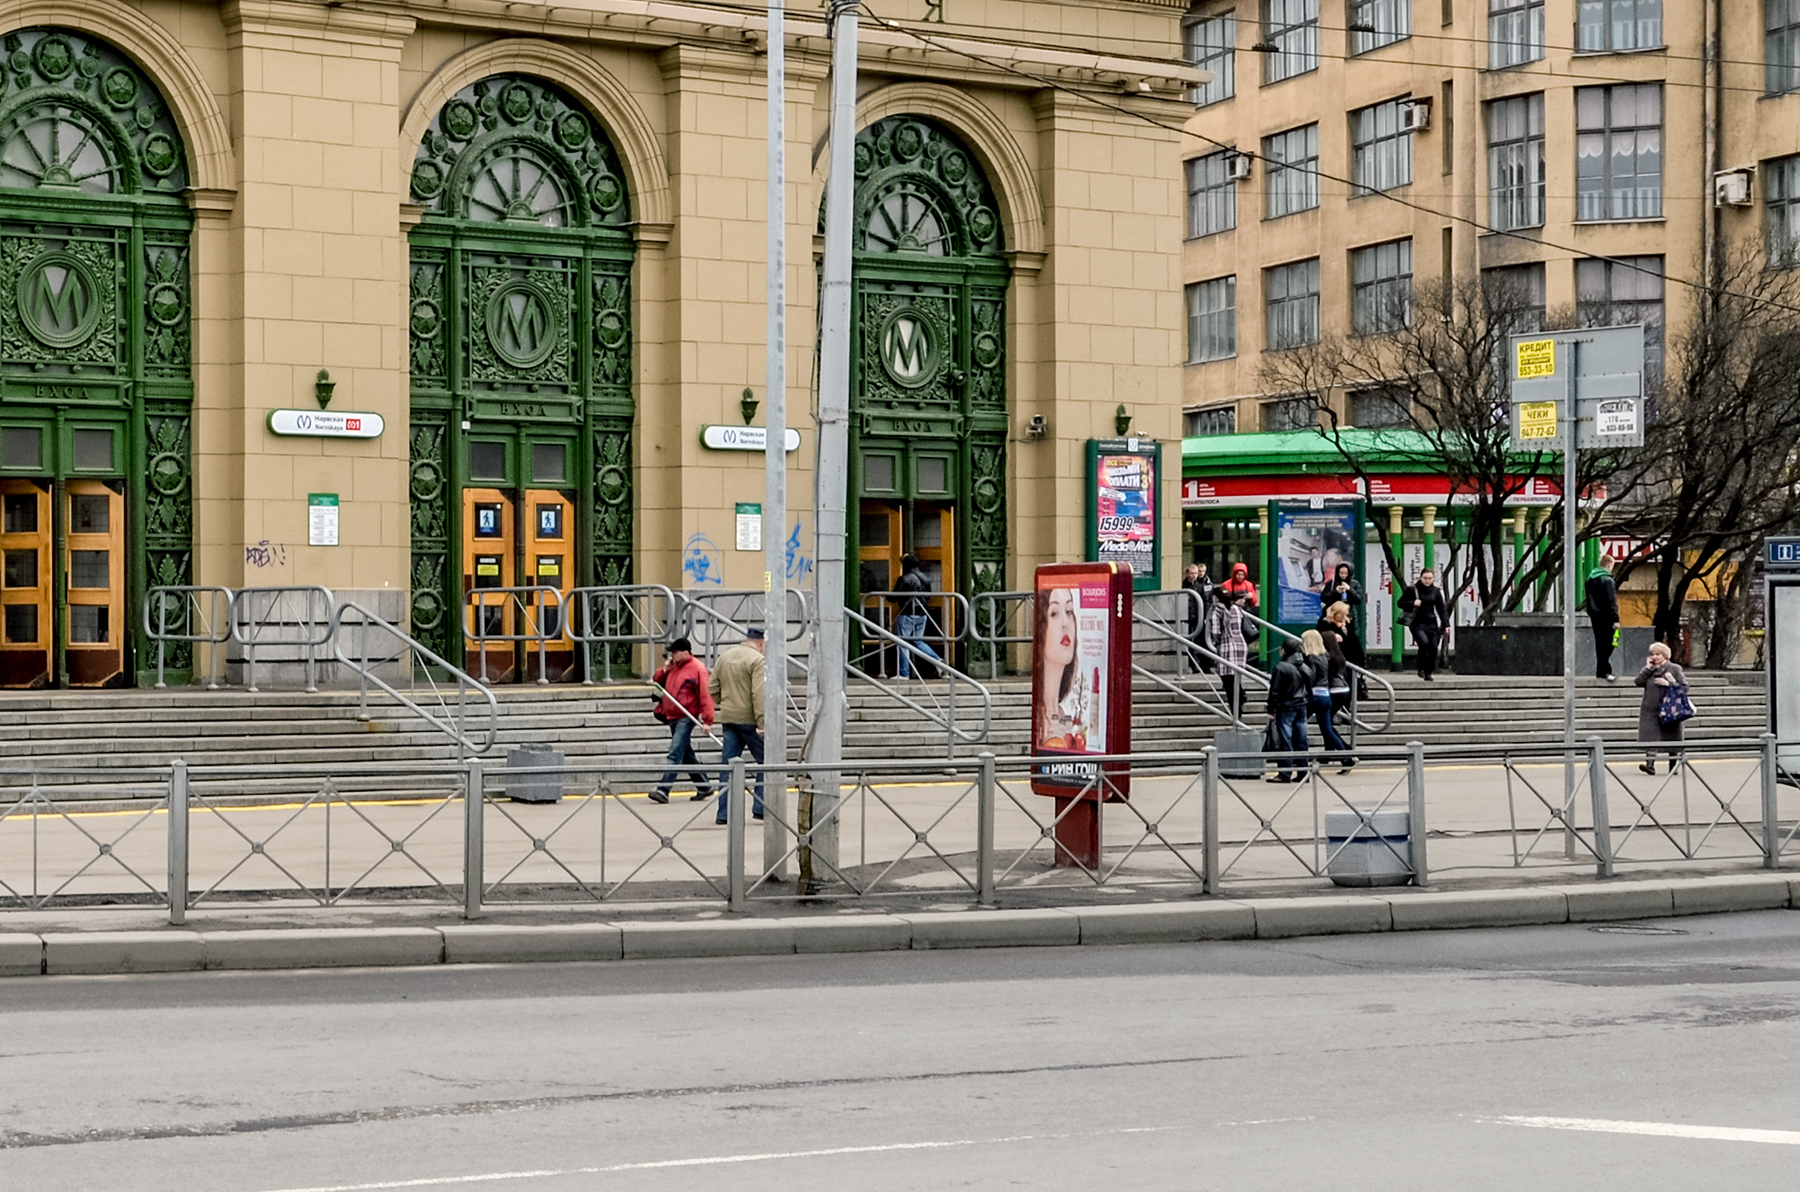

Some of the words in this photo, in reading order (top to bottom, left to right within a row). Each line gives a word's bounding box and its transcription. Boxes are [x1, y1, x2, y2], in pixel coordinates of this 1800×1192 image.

[1519, 342, 1552, 353] КРЕДИТ
[36, 386, 89, 399] ВХОД
[502, 403, 547, 416] ВХОД
[1527, 410, 1549, 419] ЧЕКИ
[315, 424, 344, 432] Narvskaya
[1521, 426, 1555, 438] 947-72-62
[1082, 588, 1106, 597] BOURJOIS
[1051, 763, 1074, 775] РИВ
[1074, 762, 1097, 779] ГОШ
